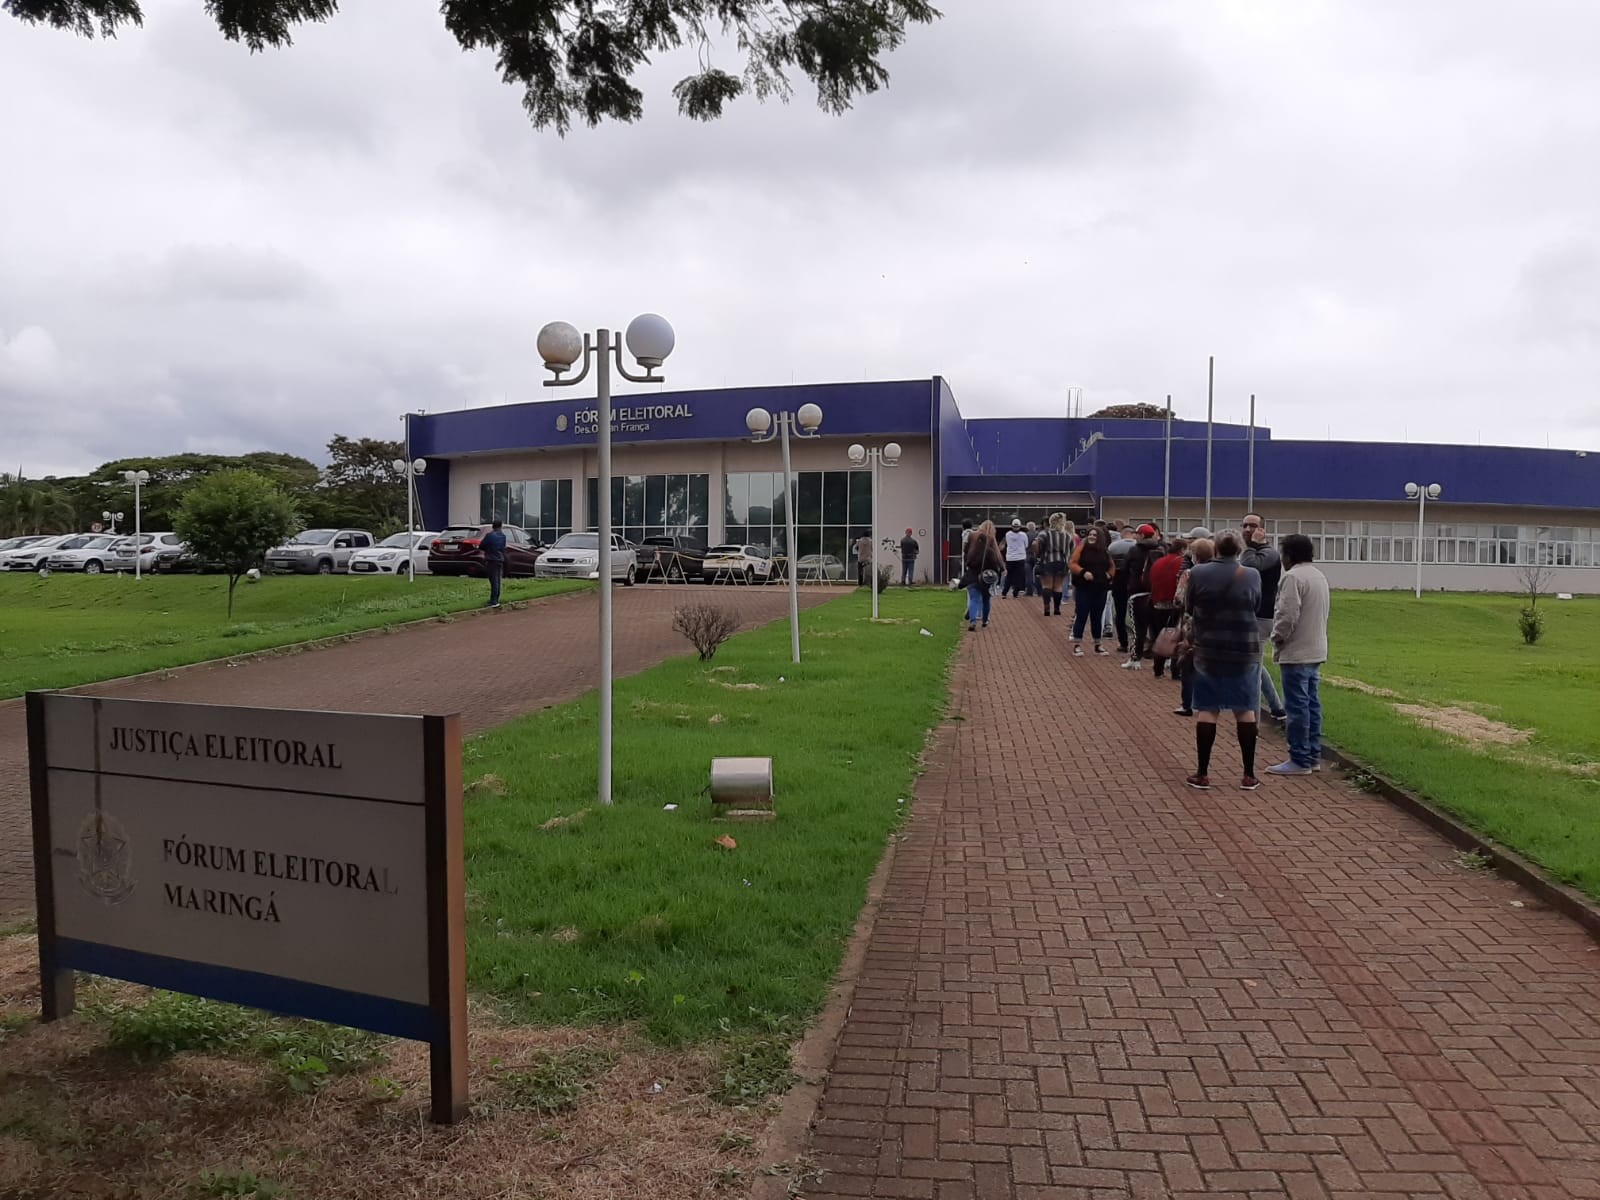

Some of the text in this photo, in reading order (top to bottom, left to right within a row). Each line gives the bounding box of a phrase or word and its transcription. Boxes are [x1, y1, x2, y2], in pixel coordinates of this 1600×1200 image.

[574, 403, 693, 424] FÓRM ELEITORAL
[620, 422, 650, 432] França
[110, 727, 343, 769] JUSTIÇA ELEITORAL
[163, 834, 399, 895] FÓRUM ELEITORAL
[164, 883, 281, 923] MARINGÁ
